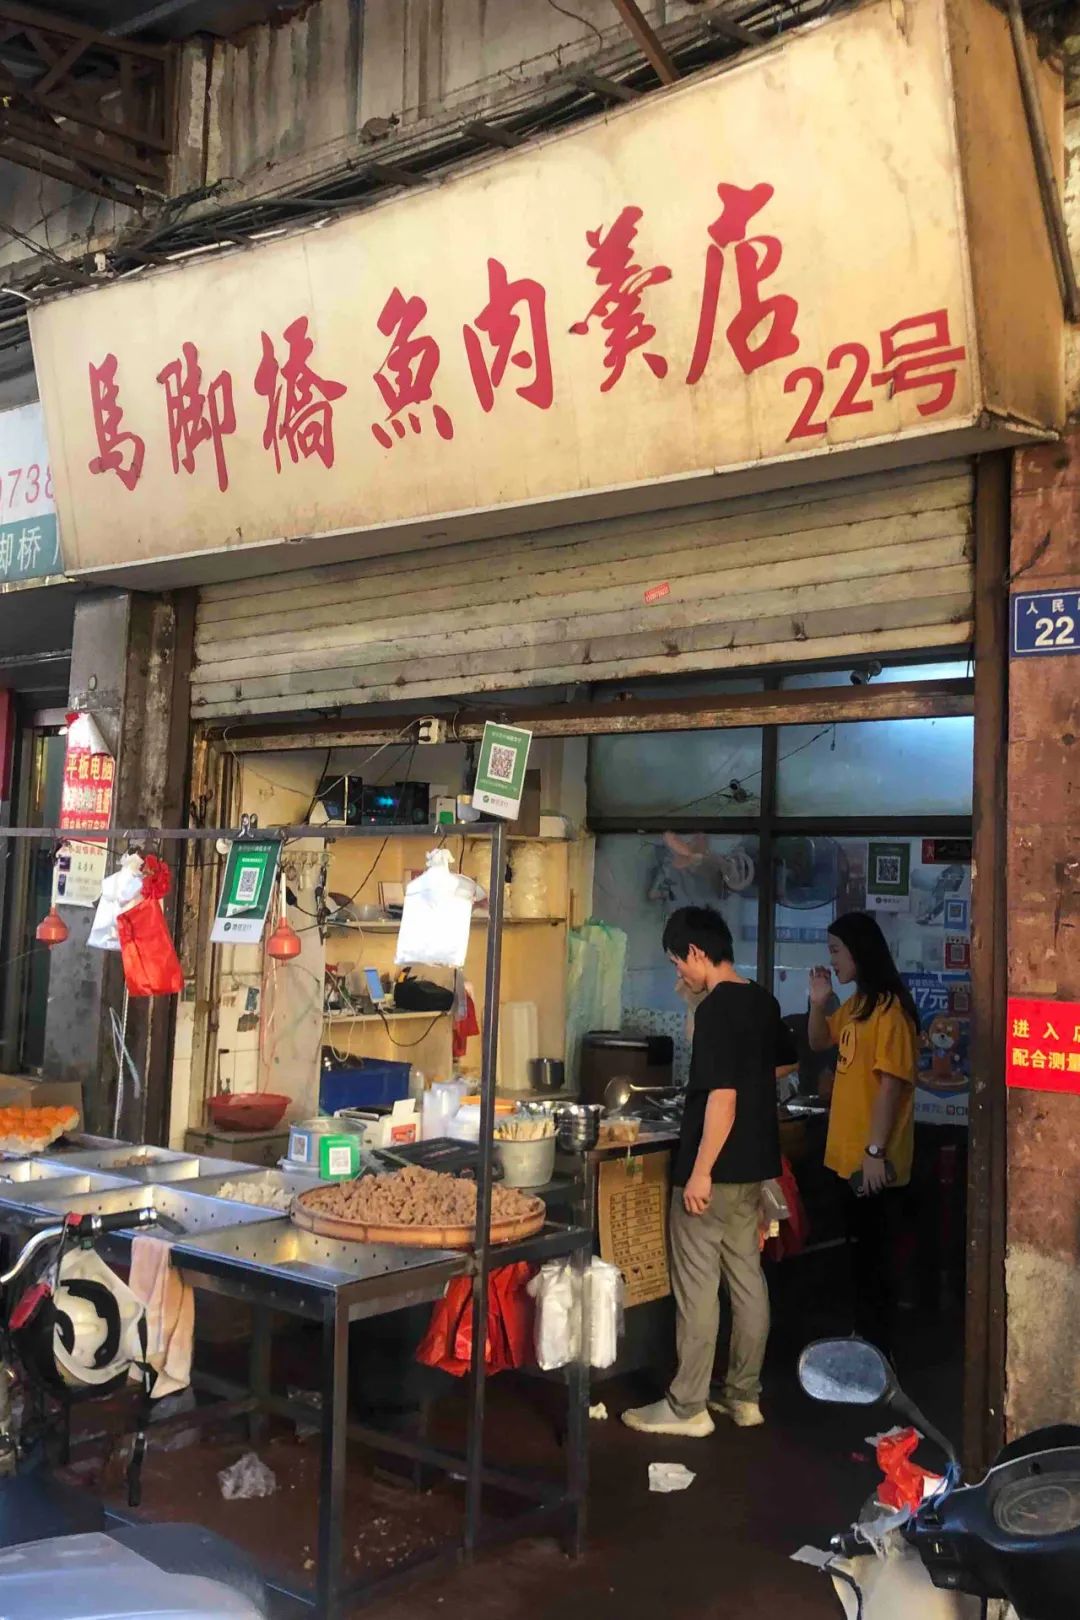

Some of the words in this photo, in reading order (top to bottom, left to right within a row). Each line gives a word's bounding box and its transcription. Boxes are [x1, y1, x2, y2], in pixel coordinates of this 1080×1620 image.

[783, 308, 966, 443] 22号
[0, 464, 55, 508] 738
[1026, 598, 1080, 615] 人民
[1035, 616, 1074, 646] 22
